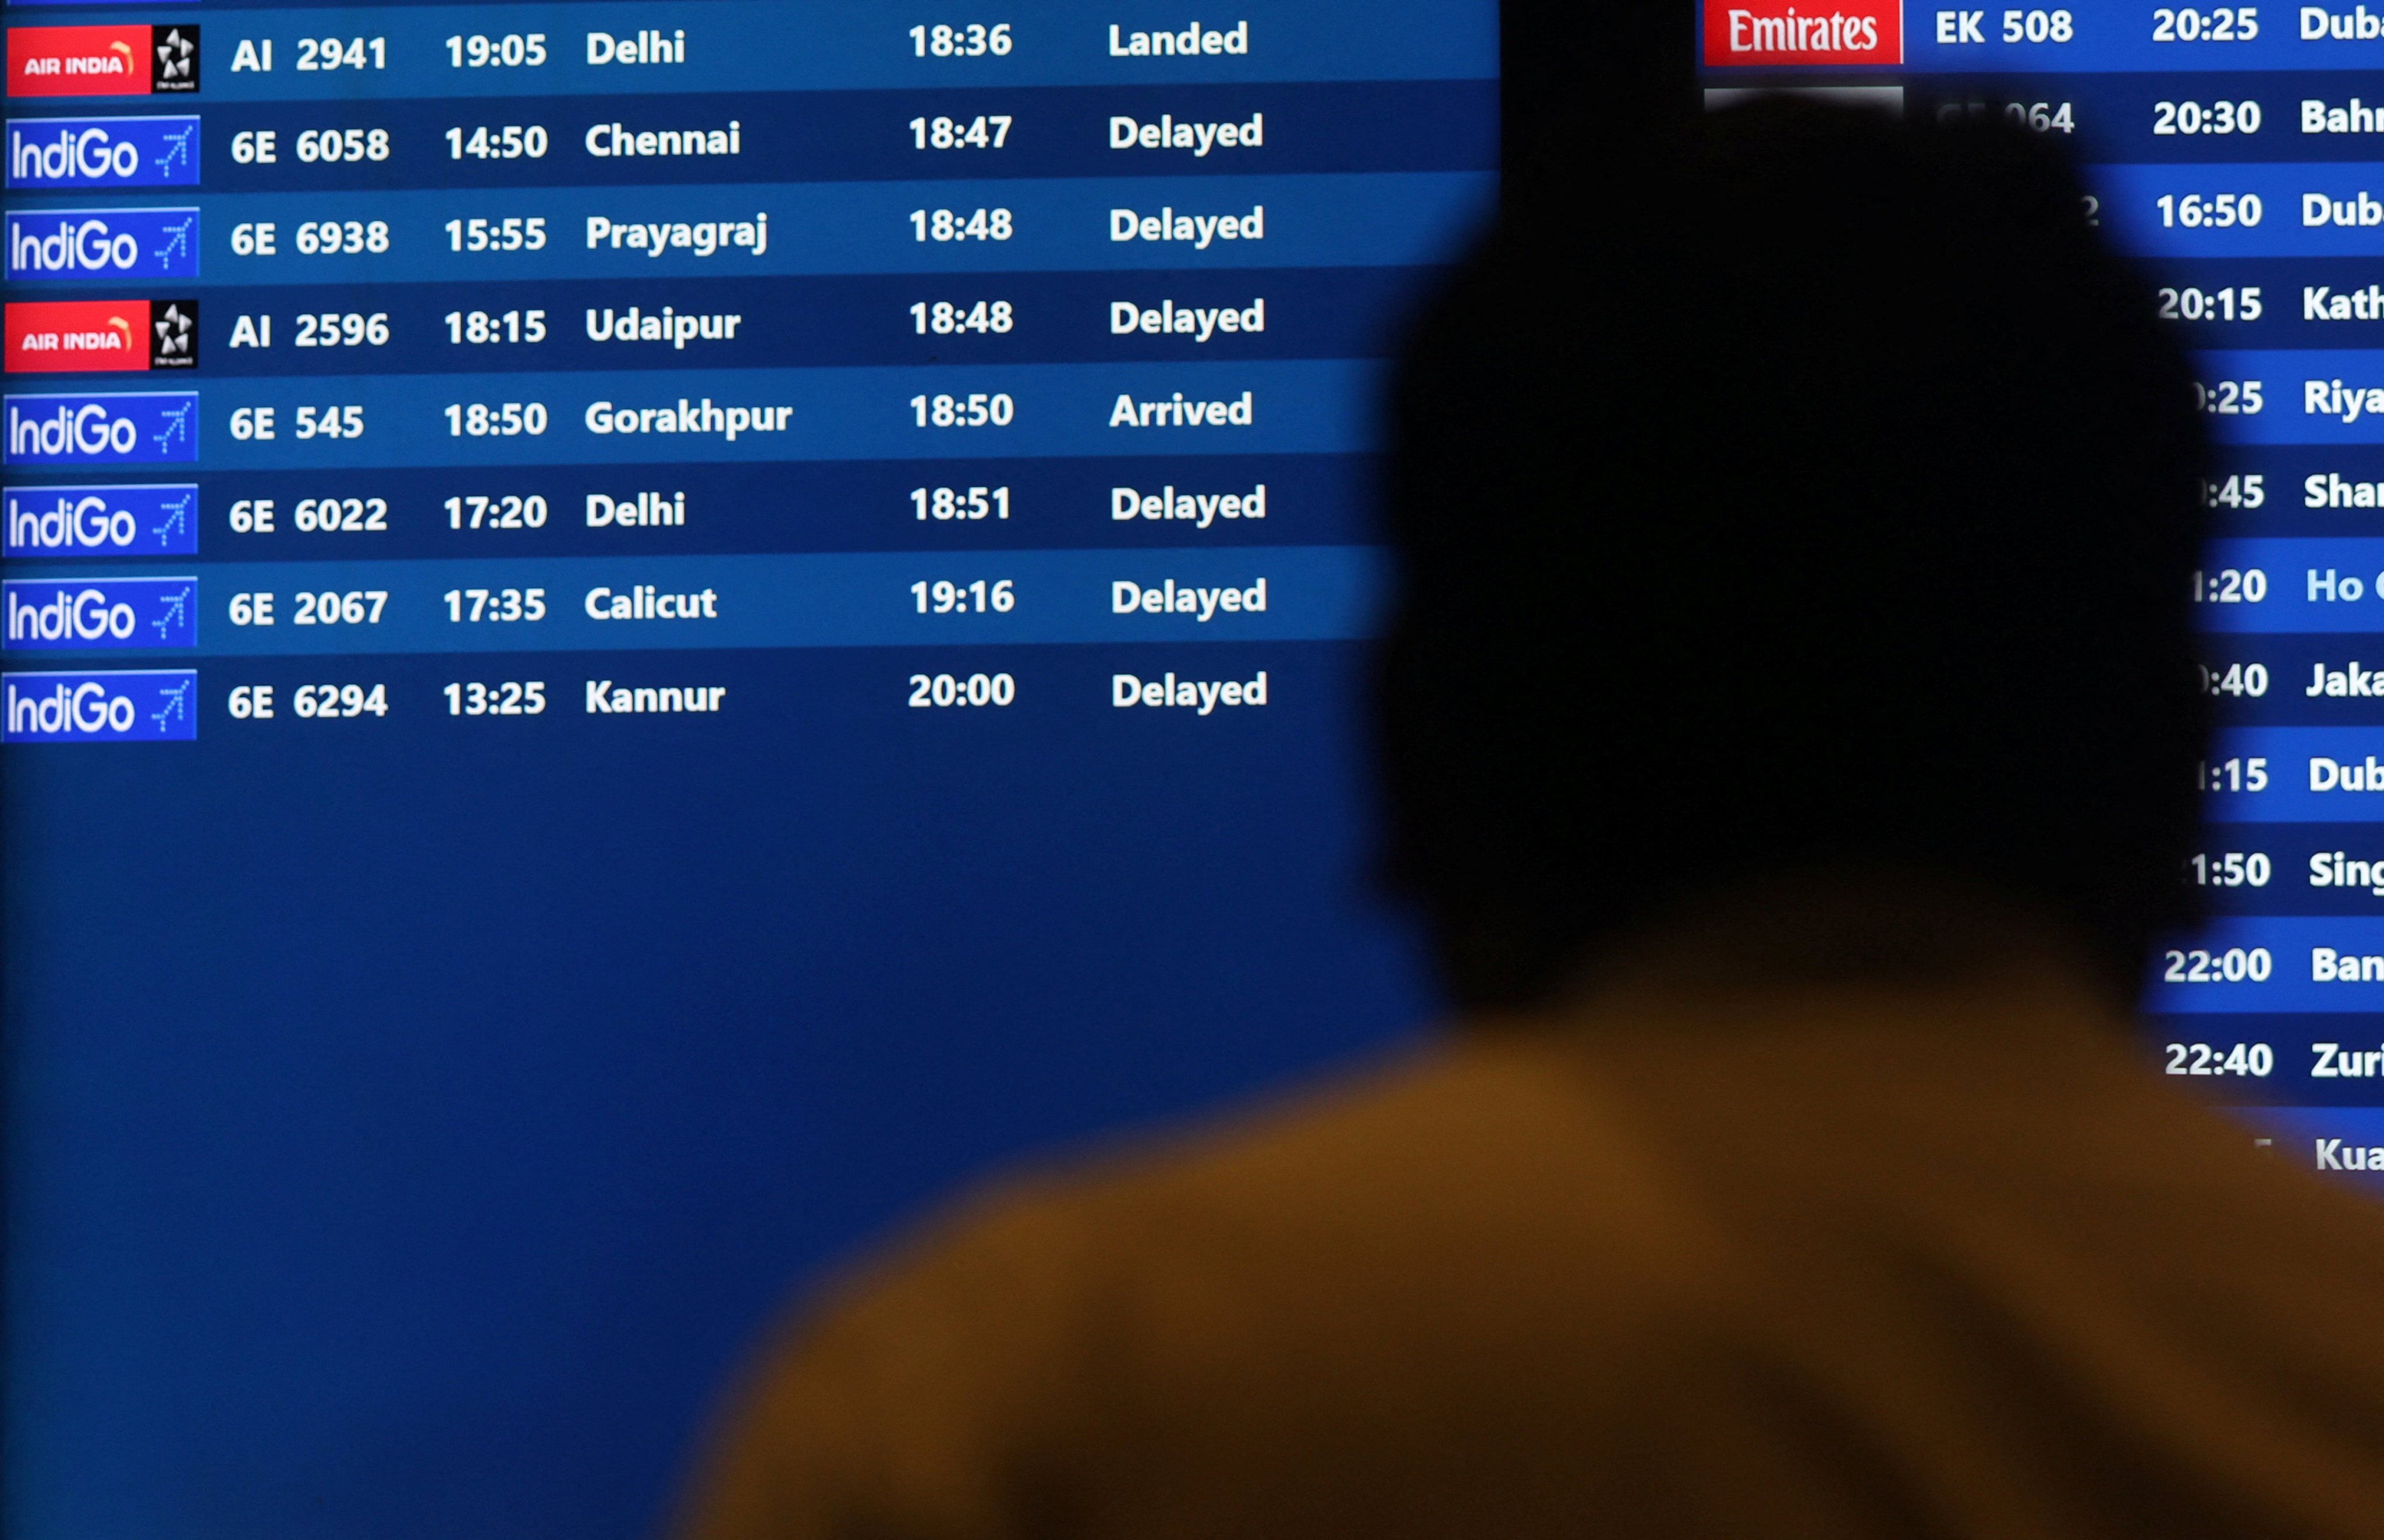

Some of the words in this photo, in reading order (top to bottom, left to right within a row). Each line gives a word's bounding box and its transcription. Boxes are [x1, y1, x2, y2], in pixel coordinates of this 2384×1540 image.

[231, 39, 272, 72] AI
[297, 37, 385, 70] 2941
[446, 34, 547, 68] 19:05
[587, 30, 685, 65] Delhi
[910, 23, 1012, 57] 18:36
[1109, 20, 1248, 56] Landed
[1728, 6, 1878, 51] Emirates
[1936, 10, 1985, 44] EK
[2003, 10, 2074, 43] 508
[2152, 8, 2259, 41] 20:25
[2300, 5, 2384, 40] Dub
[24, 57, 62, 75] AIR
[65, 56, 124, 74] INDIA
[232, 131, 276, 164] 6E
[297, 129, 389, 162] 6058
[446, 126, 548, 159] 14:50
[586, 120, 740, 157] Chennai
[910, 115, 1012, 149] 18:47
[1110, 112, 1262, 157] Delayed
[2004, 102, 2075, 134] 064
[2154, 101, 2261, 134] 20:30
[13, 128, 139, 178] IndiGo
[232, 223, 276, 256] 6E
[296, 221, 389, 254] 6938
[446, 218, 547, 251] 15:55
[587, 212, 767, 257] Prayagraj
[910, 208, 1013, 242] 18:48
[1111, 205, 1264, 250] Delayed
[2157, 194, 2262, 228] 16:50
[2303, 191, 2384, 226] Dub
[12, 219, 138, 270] IndiGo
[230, 315, 271, 348] AI
[295, 313, 389, 346] 2596
[445, 310, 546, 344] 18:15
[587, 306, 742, 349] Udaipur
[910, 301, 1013, 334] 18:48
[1111, 298, 1264, 342] Delayed
[2158, 287, 2262, 321] 20:15
[2304, 285, 2384, 320] Kath
[22, 332, 59, 351] AIR
[62, 331, 122, 350] INDIA
[230, 407, 275, 440] 6E
[296, 406, 364, 439] 545
[445, 403, 548, 437] 18:50
[586, 398, 793, 441] Gorakhpur
[910, 393, 1014, 427] 18:50
[1109, 391, 1252, 427] Arrived
[2305, 379, 2384, 423] Riya
[10, 404, 137, 455] IndiGo
[10, 496, 136, 547] IndiGo
[230, 500, 275, 533] 6E
[295, 498, 387, 531] 6022
[445, 495, 548, 529] 17:20
[587, 491, 685, 527] Delhi
[911, 487, 1009, 520] 18:51
[1112, 484, 1265, 528] Delayed
[229, 592, 274, 626] 6E
[294, 591, 388, 624] 2067
[444, 588, 546, 622] 17:35
[585, 585, 718, 620] Calicut
[911, 580, 1014, 613] 19:16
[1113, 577, 1266, 622] Delayed
[2307, 569, 2364, 601] Ho
[9, 589, 136, 640] IndiGo
[9, 682, 135, 733] IndiGo
[229, 686, 274, 719] 6E
[294, 684, 388, 718] 6294
[444, 682, 546, 715] 13:25
[587, 680, 726, 713] Kannur
[909, 673, 1015, 707] 20:00
[1113, 671, 1267, 716] Delayed
[2310, 756, 2384, 792] Dub
[2182, 853, 2271, 886] 1:50
[2310, 851, 2384, 896] Sing
[2165, 948, 2272, 982] 22:00
[2312, 948, 2384, 981] Ban
[2165, 1043, 2273, 1077] 22:40
[2315, 1138, 2384, 1171] Kua
